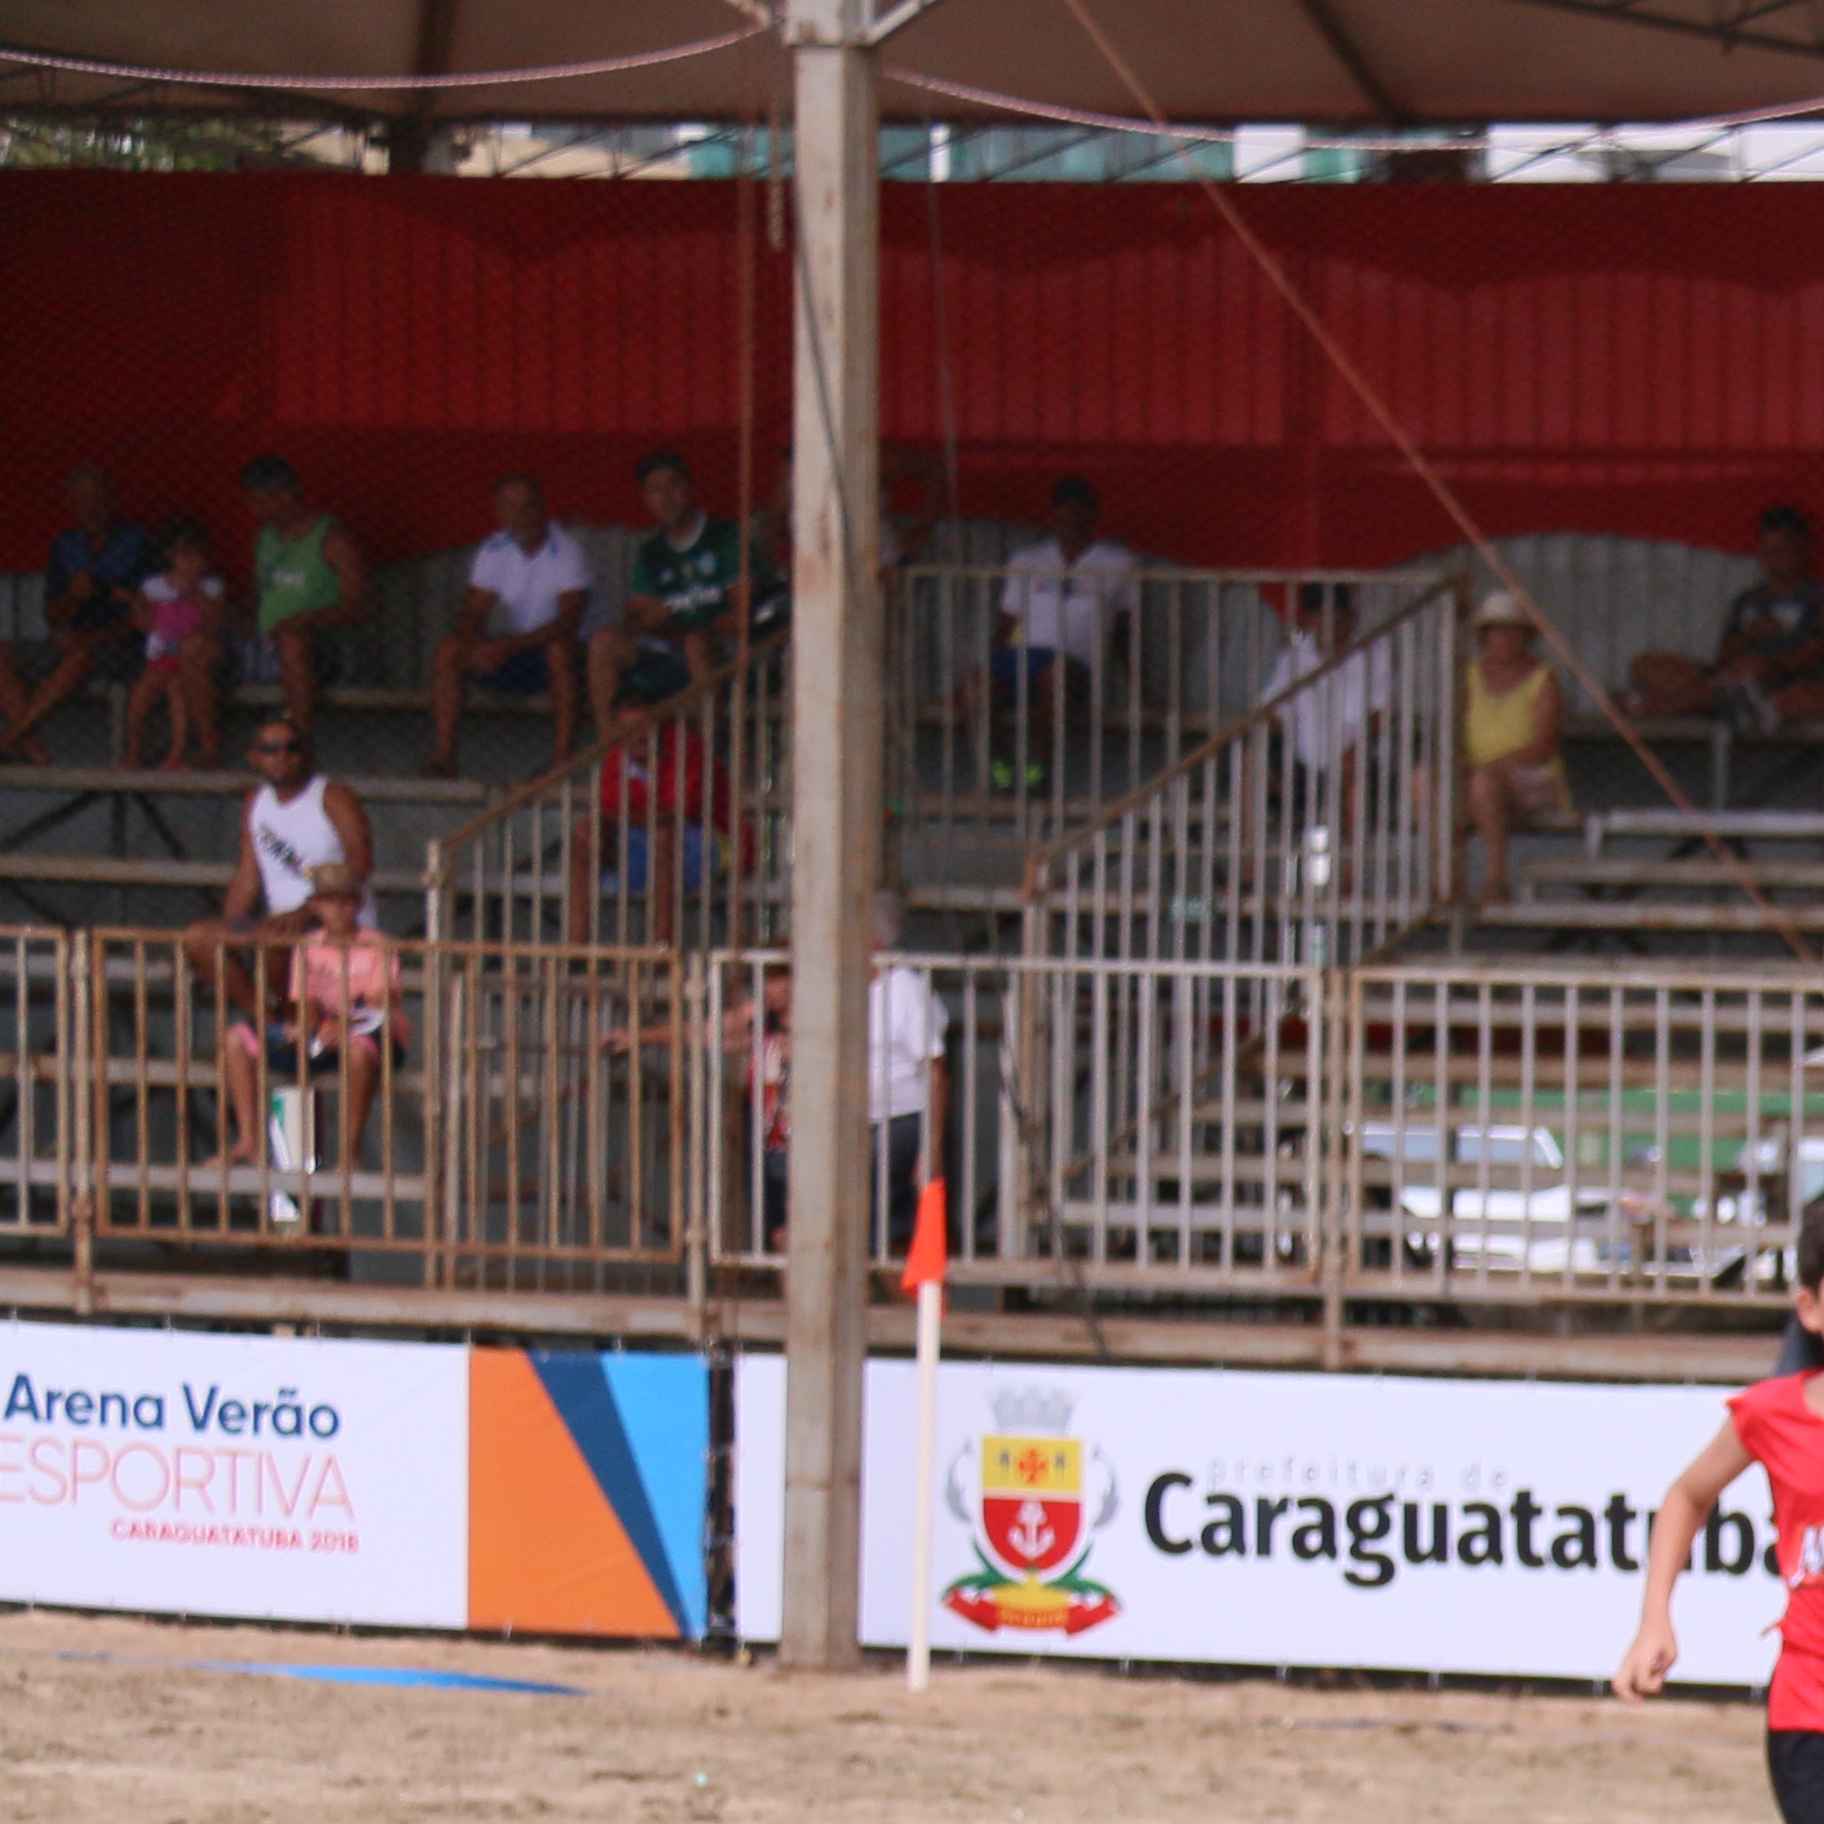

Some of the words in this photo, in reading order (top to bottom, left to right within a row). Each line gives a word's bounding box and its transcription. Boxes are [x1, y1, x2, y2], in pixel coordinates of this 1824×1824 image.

[4, 1372, 165, 1429] Arena
[181, 1381, 341, 1439] Verão
[1463, 1460, 1512, 1489] de
[1143, 1472, 1783, 1588] Caraguatatb
